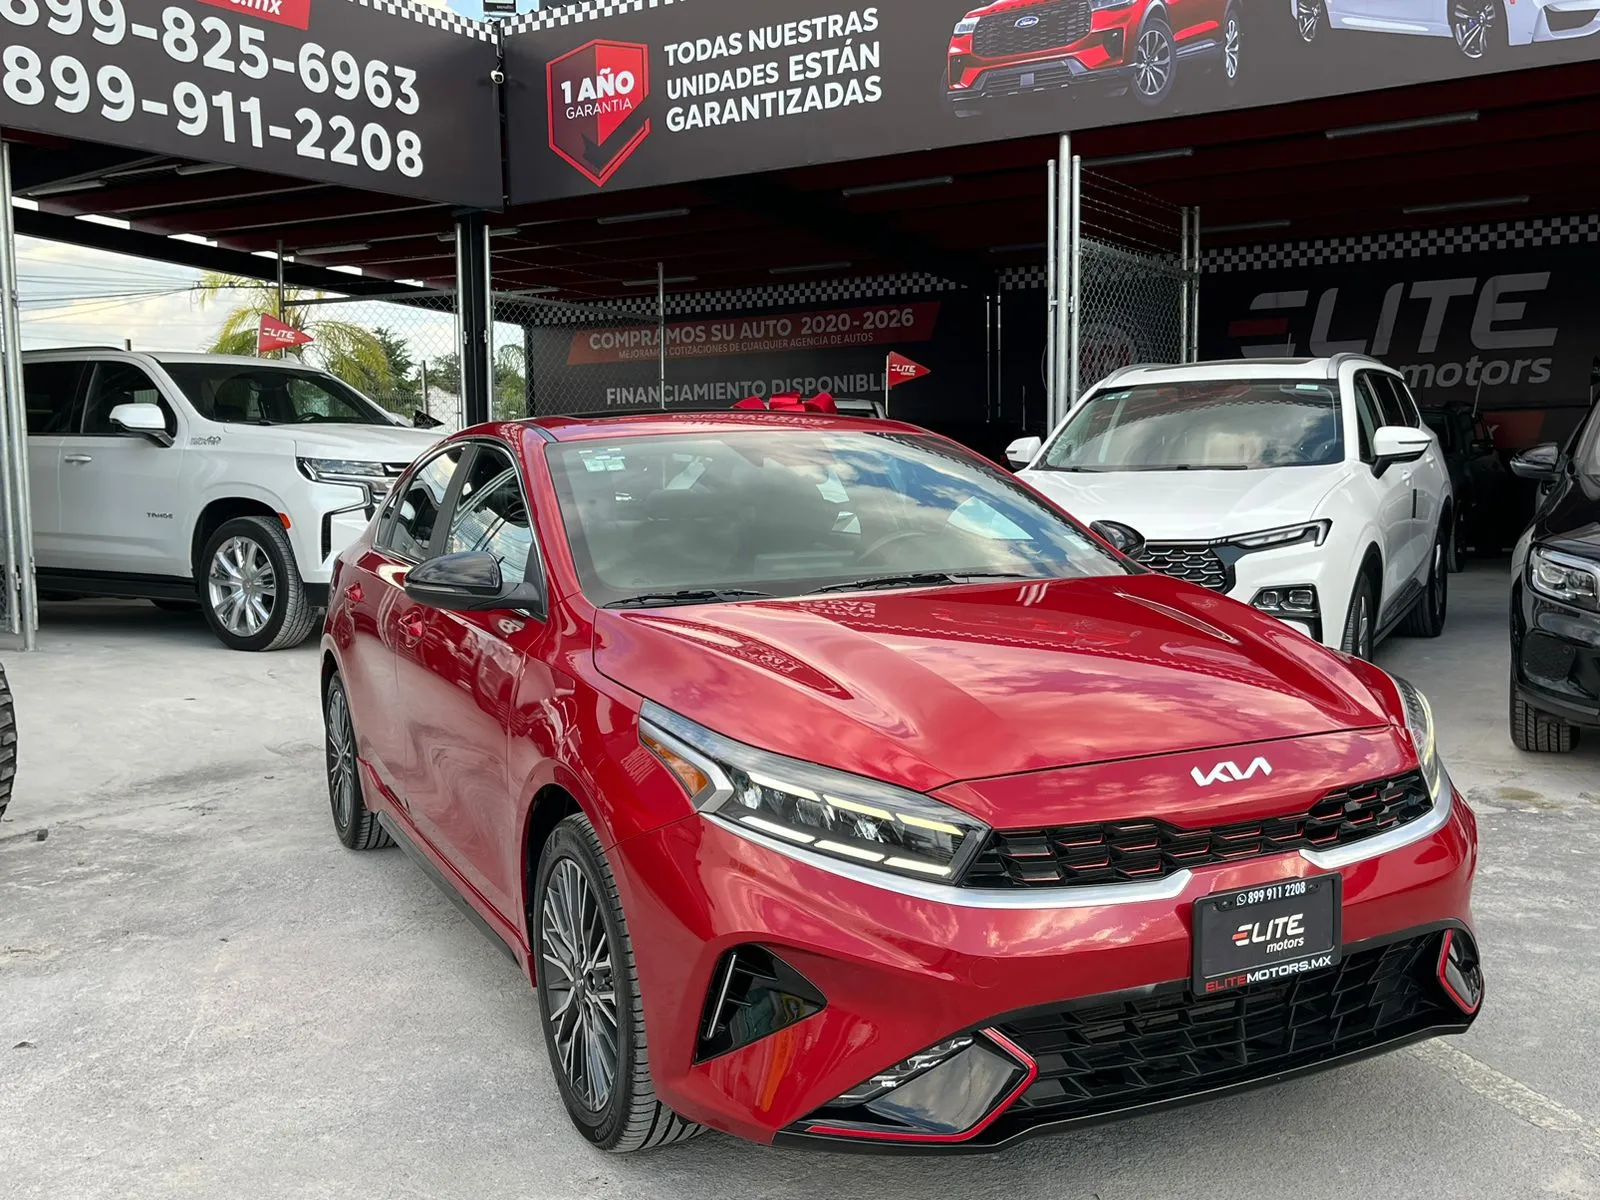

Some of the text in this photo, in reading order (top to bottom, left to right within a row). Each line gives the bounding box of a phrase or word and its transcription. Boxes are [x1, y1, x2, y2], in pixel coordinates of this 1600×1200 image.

[664, 7, 879, 67] TODAS NUESTRAS
[561, 67, 635, 104] 1 AÑO
[666, 40, 881, 101] UNIDADES ESTÁN
[2, 44, 424, 178] 899-911-2208
[566, 97, 632, 119] GARANTIA
[666, 75, 882, 133] GARANTIZADAS
[1227, 271, 1558, 358] ELITE
[263, 328, 295, 339] ELITE
[589, 325, 706, 350] COMPRAMOS
[711, 323, 735, 342] SU
[740, 318, 792, 340] AUTO
[669, 343, 728, 356] COTIZACIONES
[729, 342, 741, 352] DE
[741, 339, 789, 352] CUALQUIER
[789, 335, 828, 348] AGENCIA
[831, 334, 843, 345] DE
[844, 332, 873, 344] AUTOS
[1400, 353, 1552, 388] motors
[606, 379, 767, 405] FINANCIAMIENTO
[1247, 881, 1306, 904] 899 911 2208
[1232, 913, 1305, 947] ELITE
[1266, 936, 1305, 953] motors
[1205, 955, 1331, 992] ELITEMOTORS.MX
